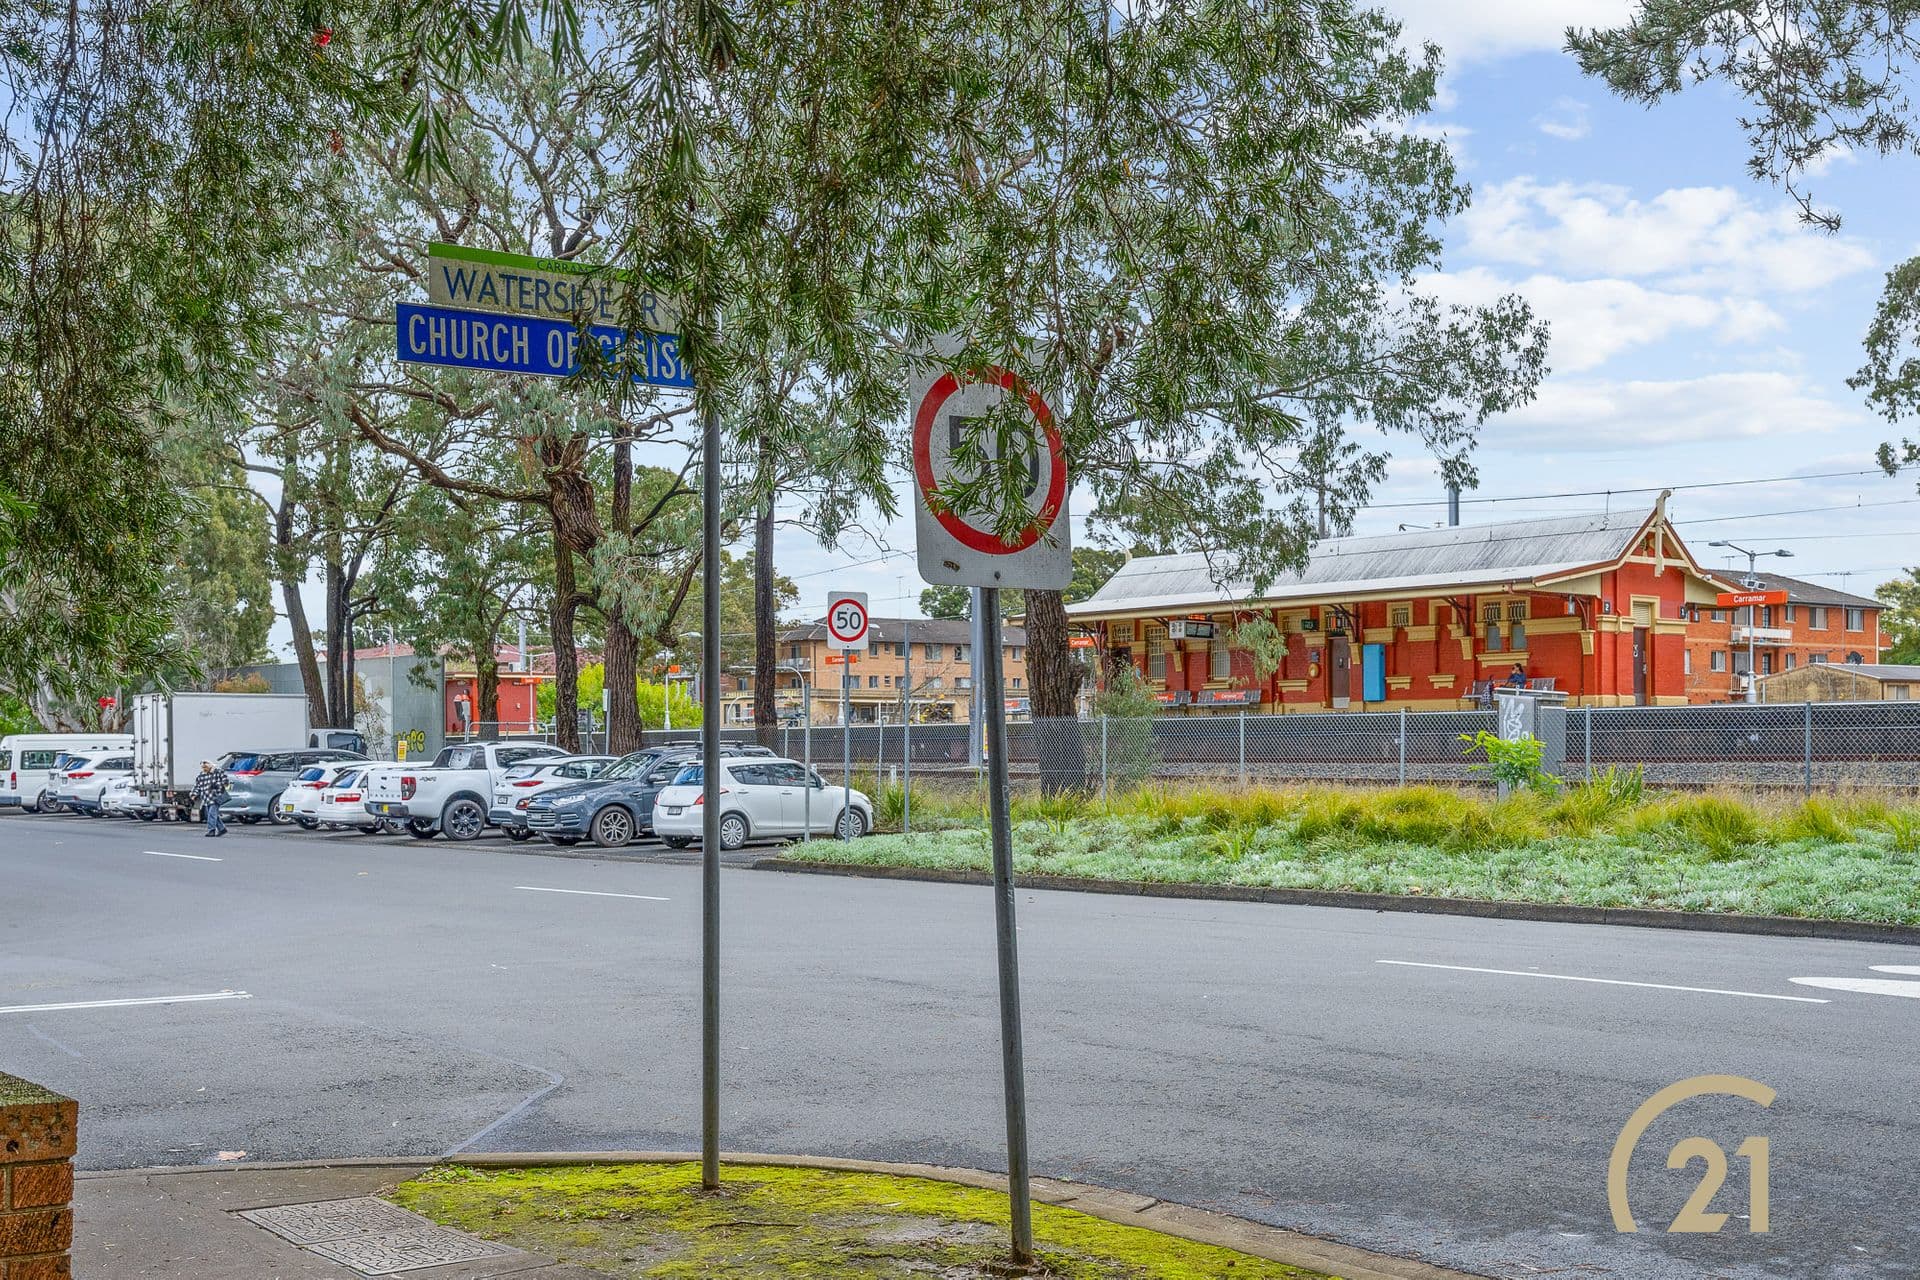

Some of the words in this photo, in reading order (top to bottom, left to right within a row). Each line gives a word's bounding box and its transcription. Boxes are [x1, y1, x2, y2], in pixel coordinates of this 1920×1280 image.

[444, 265, 615, 321] WATERSIDE
[408, 313, 530, 366] CHURCH
[546, 328, 579, 370] OF
[1733, 594, 1767, 604] Carramar
[836, 611, 862, 630] 50
